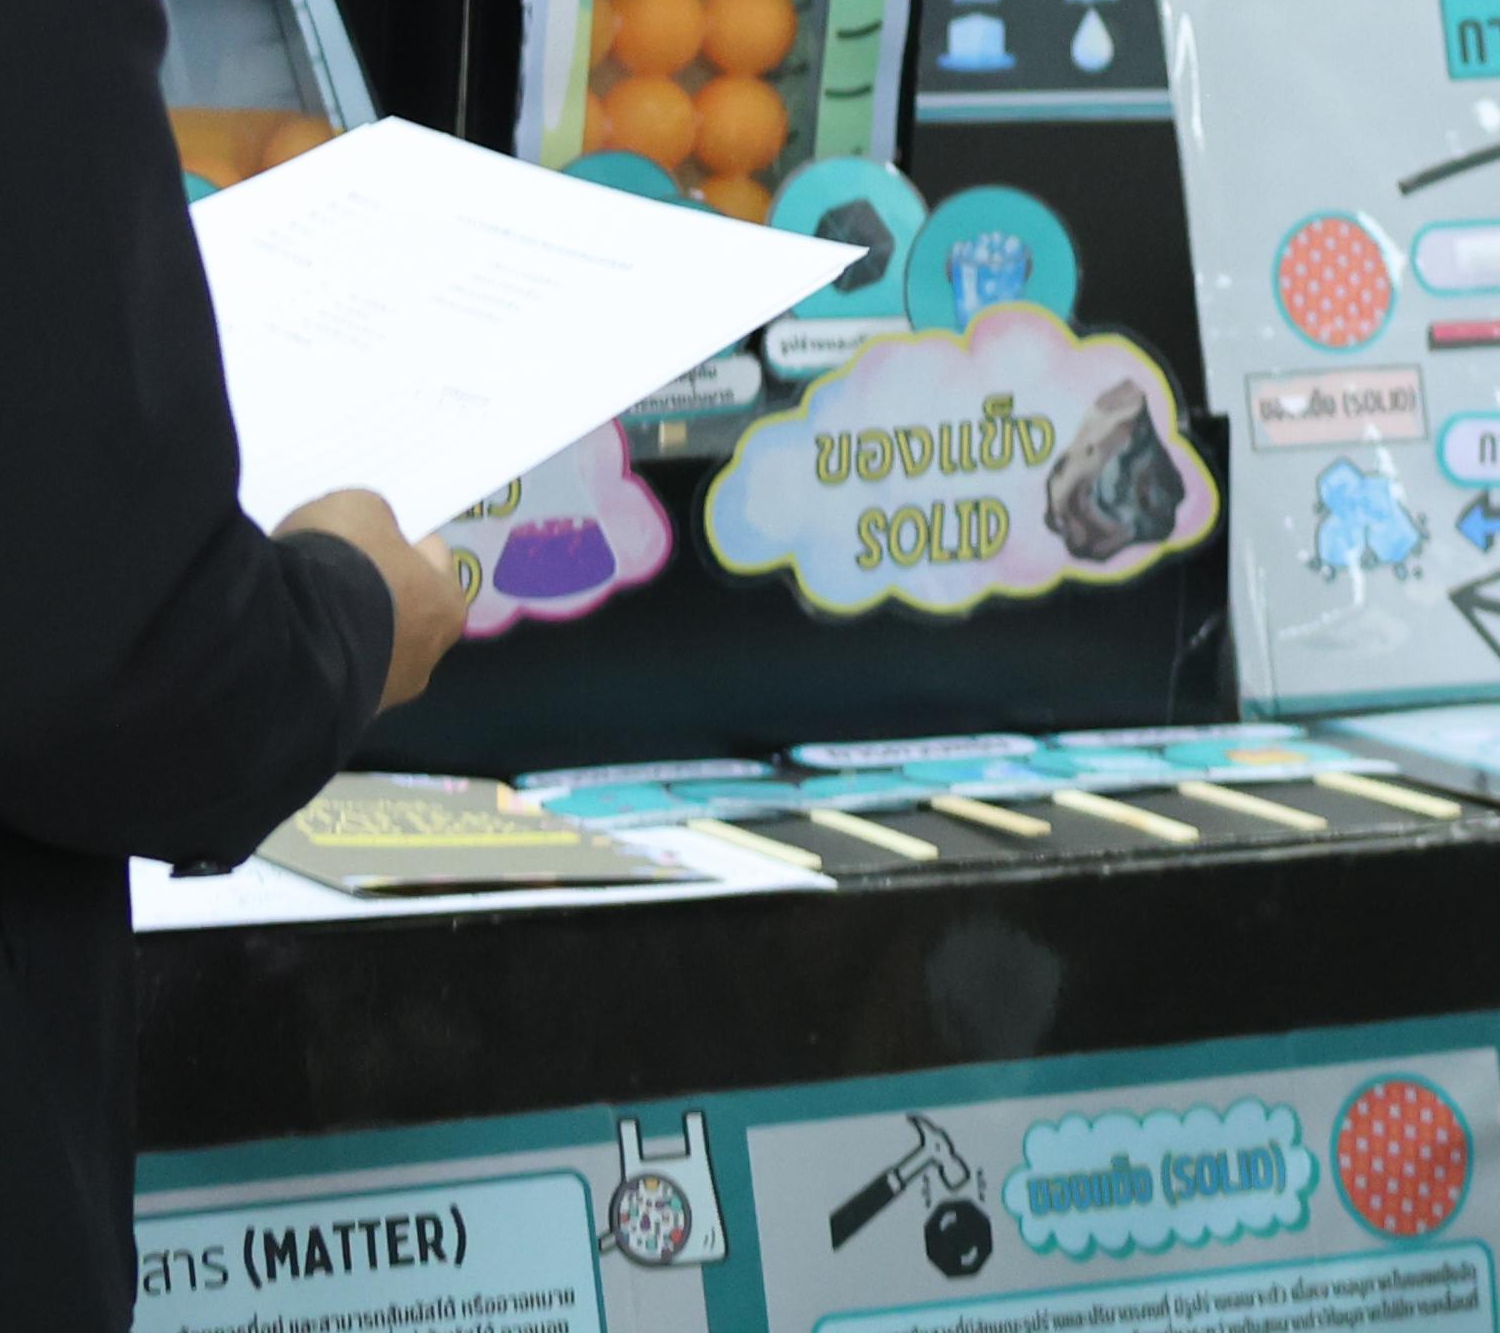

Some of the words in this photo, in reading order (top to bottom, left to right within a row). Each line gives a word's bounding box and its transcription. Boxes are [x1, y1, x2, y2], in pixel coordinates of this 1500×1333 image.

[814, 393, 1056, 485] ของแข็ง
[857, 499, 1010, 569] SOLID
[1160, 1138, 1286, 1208] (SOLID)
[242, 1204, 467, 1290] (MATTER)
